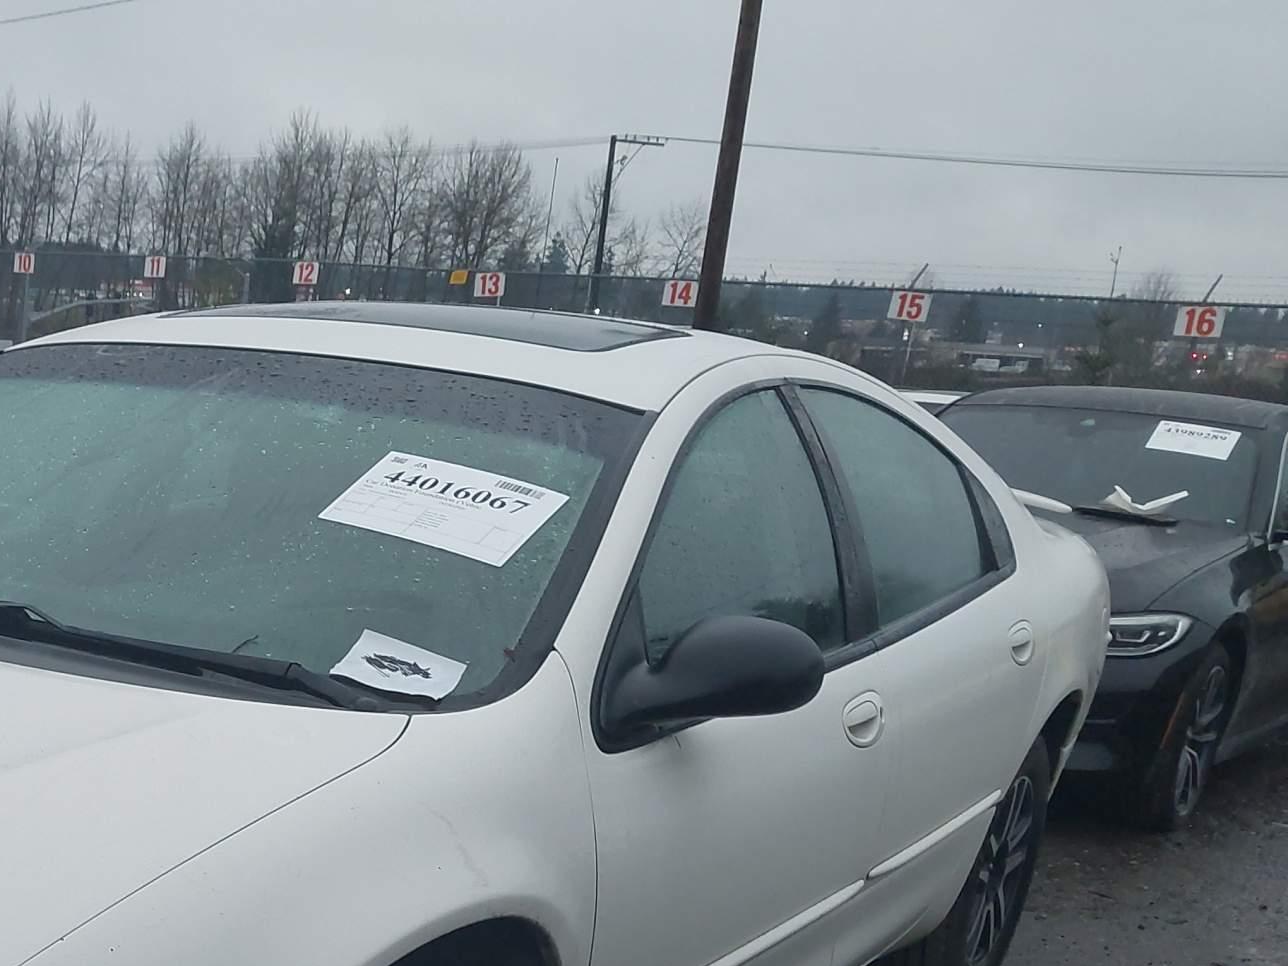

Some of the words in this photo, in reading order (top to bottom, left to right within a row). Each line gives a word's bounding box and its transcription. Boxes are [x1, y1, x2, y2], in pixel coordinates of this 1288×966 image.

[16, 255, 32, 273] 10
[150, 257, 161, 276] 11
[298, 262, 315, 283] 12
[479, 273, 500, 296] 13
[669, 281, 693, 305] 14
[895, 292, 923, 320] 15
[1184, 307, 1216, 336] 16
[384, 470, 533, 514] 44016067
